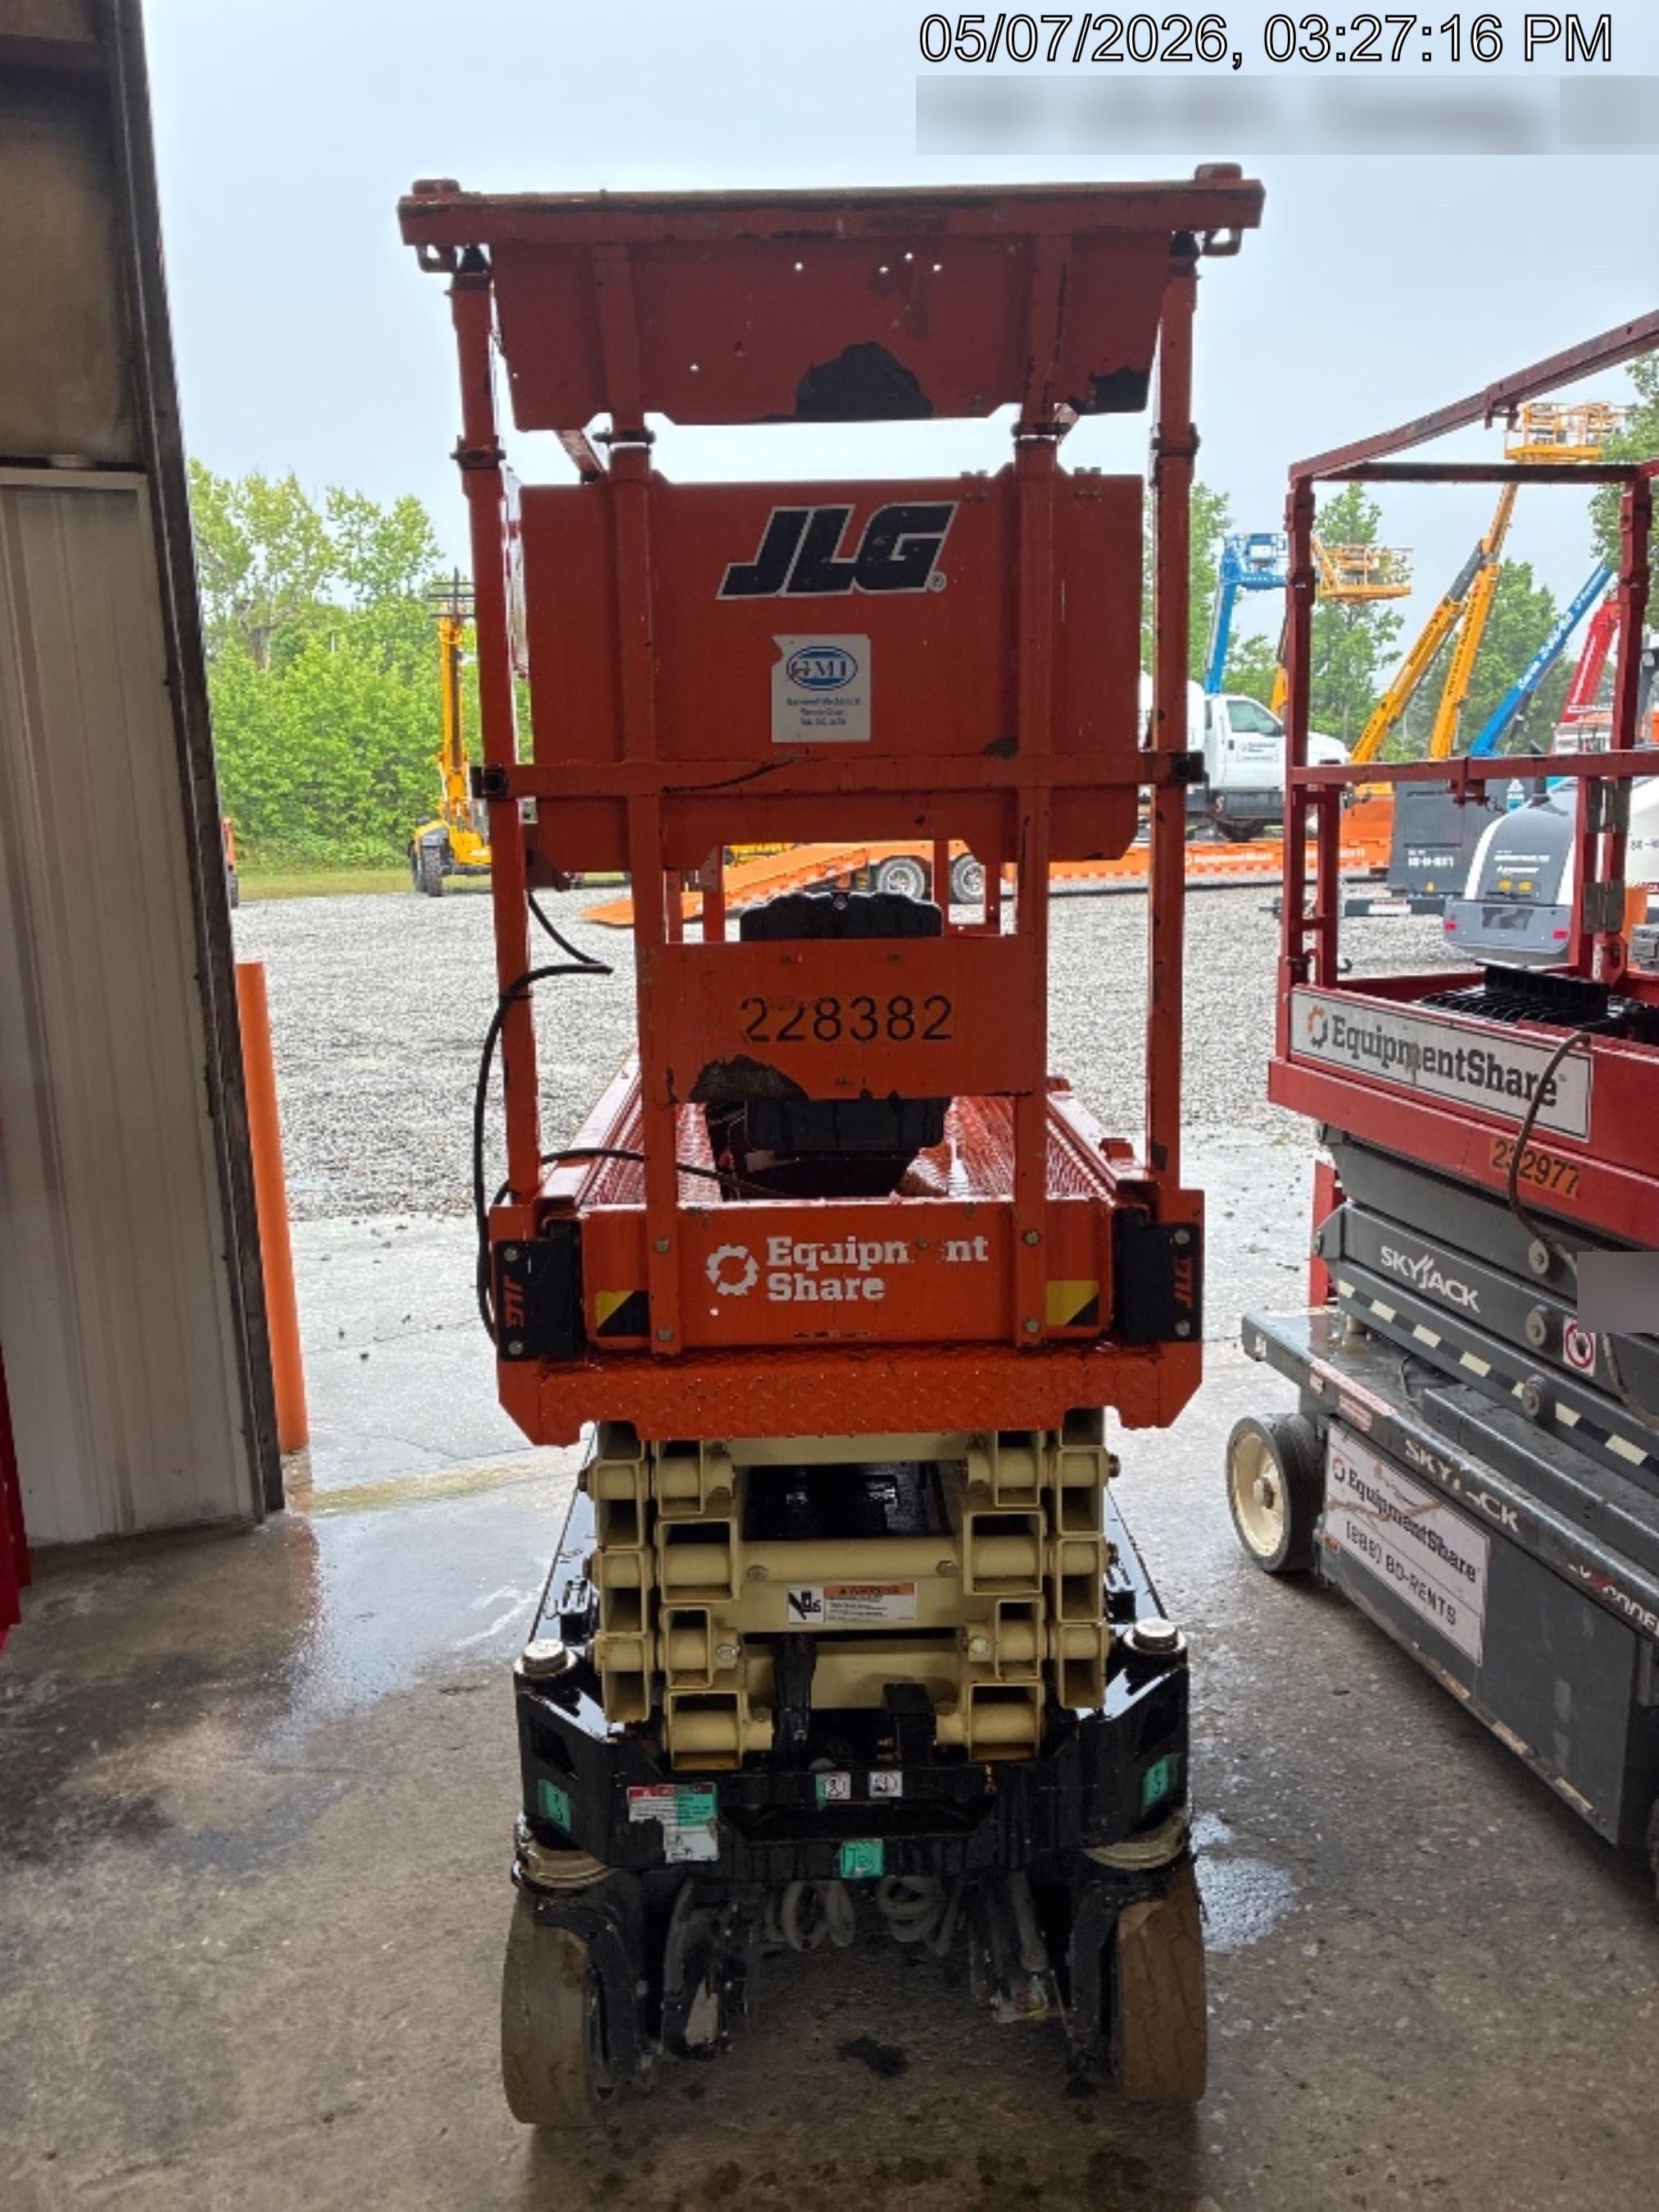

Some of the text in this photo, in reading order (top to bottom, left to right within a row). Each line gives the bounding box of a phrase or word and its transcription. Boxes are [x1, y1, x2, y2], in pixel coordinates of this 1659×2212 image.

[715, 501, 959, 600] JLG
[740, 995, 953, 1043] 228382
[766, 1235, 989, 1271] Equipmnt
[1380, 1245, 1481, 1313] SKYJACK
[504, 1274, 525, 1328] JLG
[767, 1272, 886, 1301] Share
[1405, 1438, 1520, 1533] SKYCK
[1346, 1467, 1478, 1584] EquipmentShare
